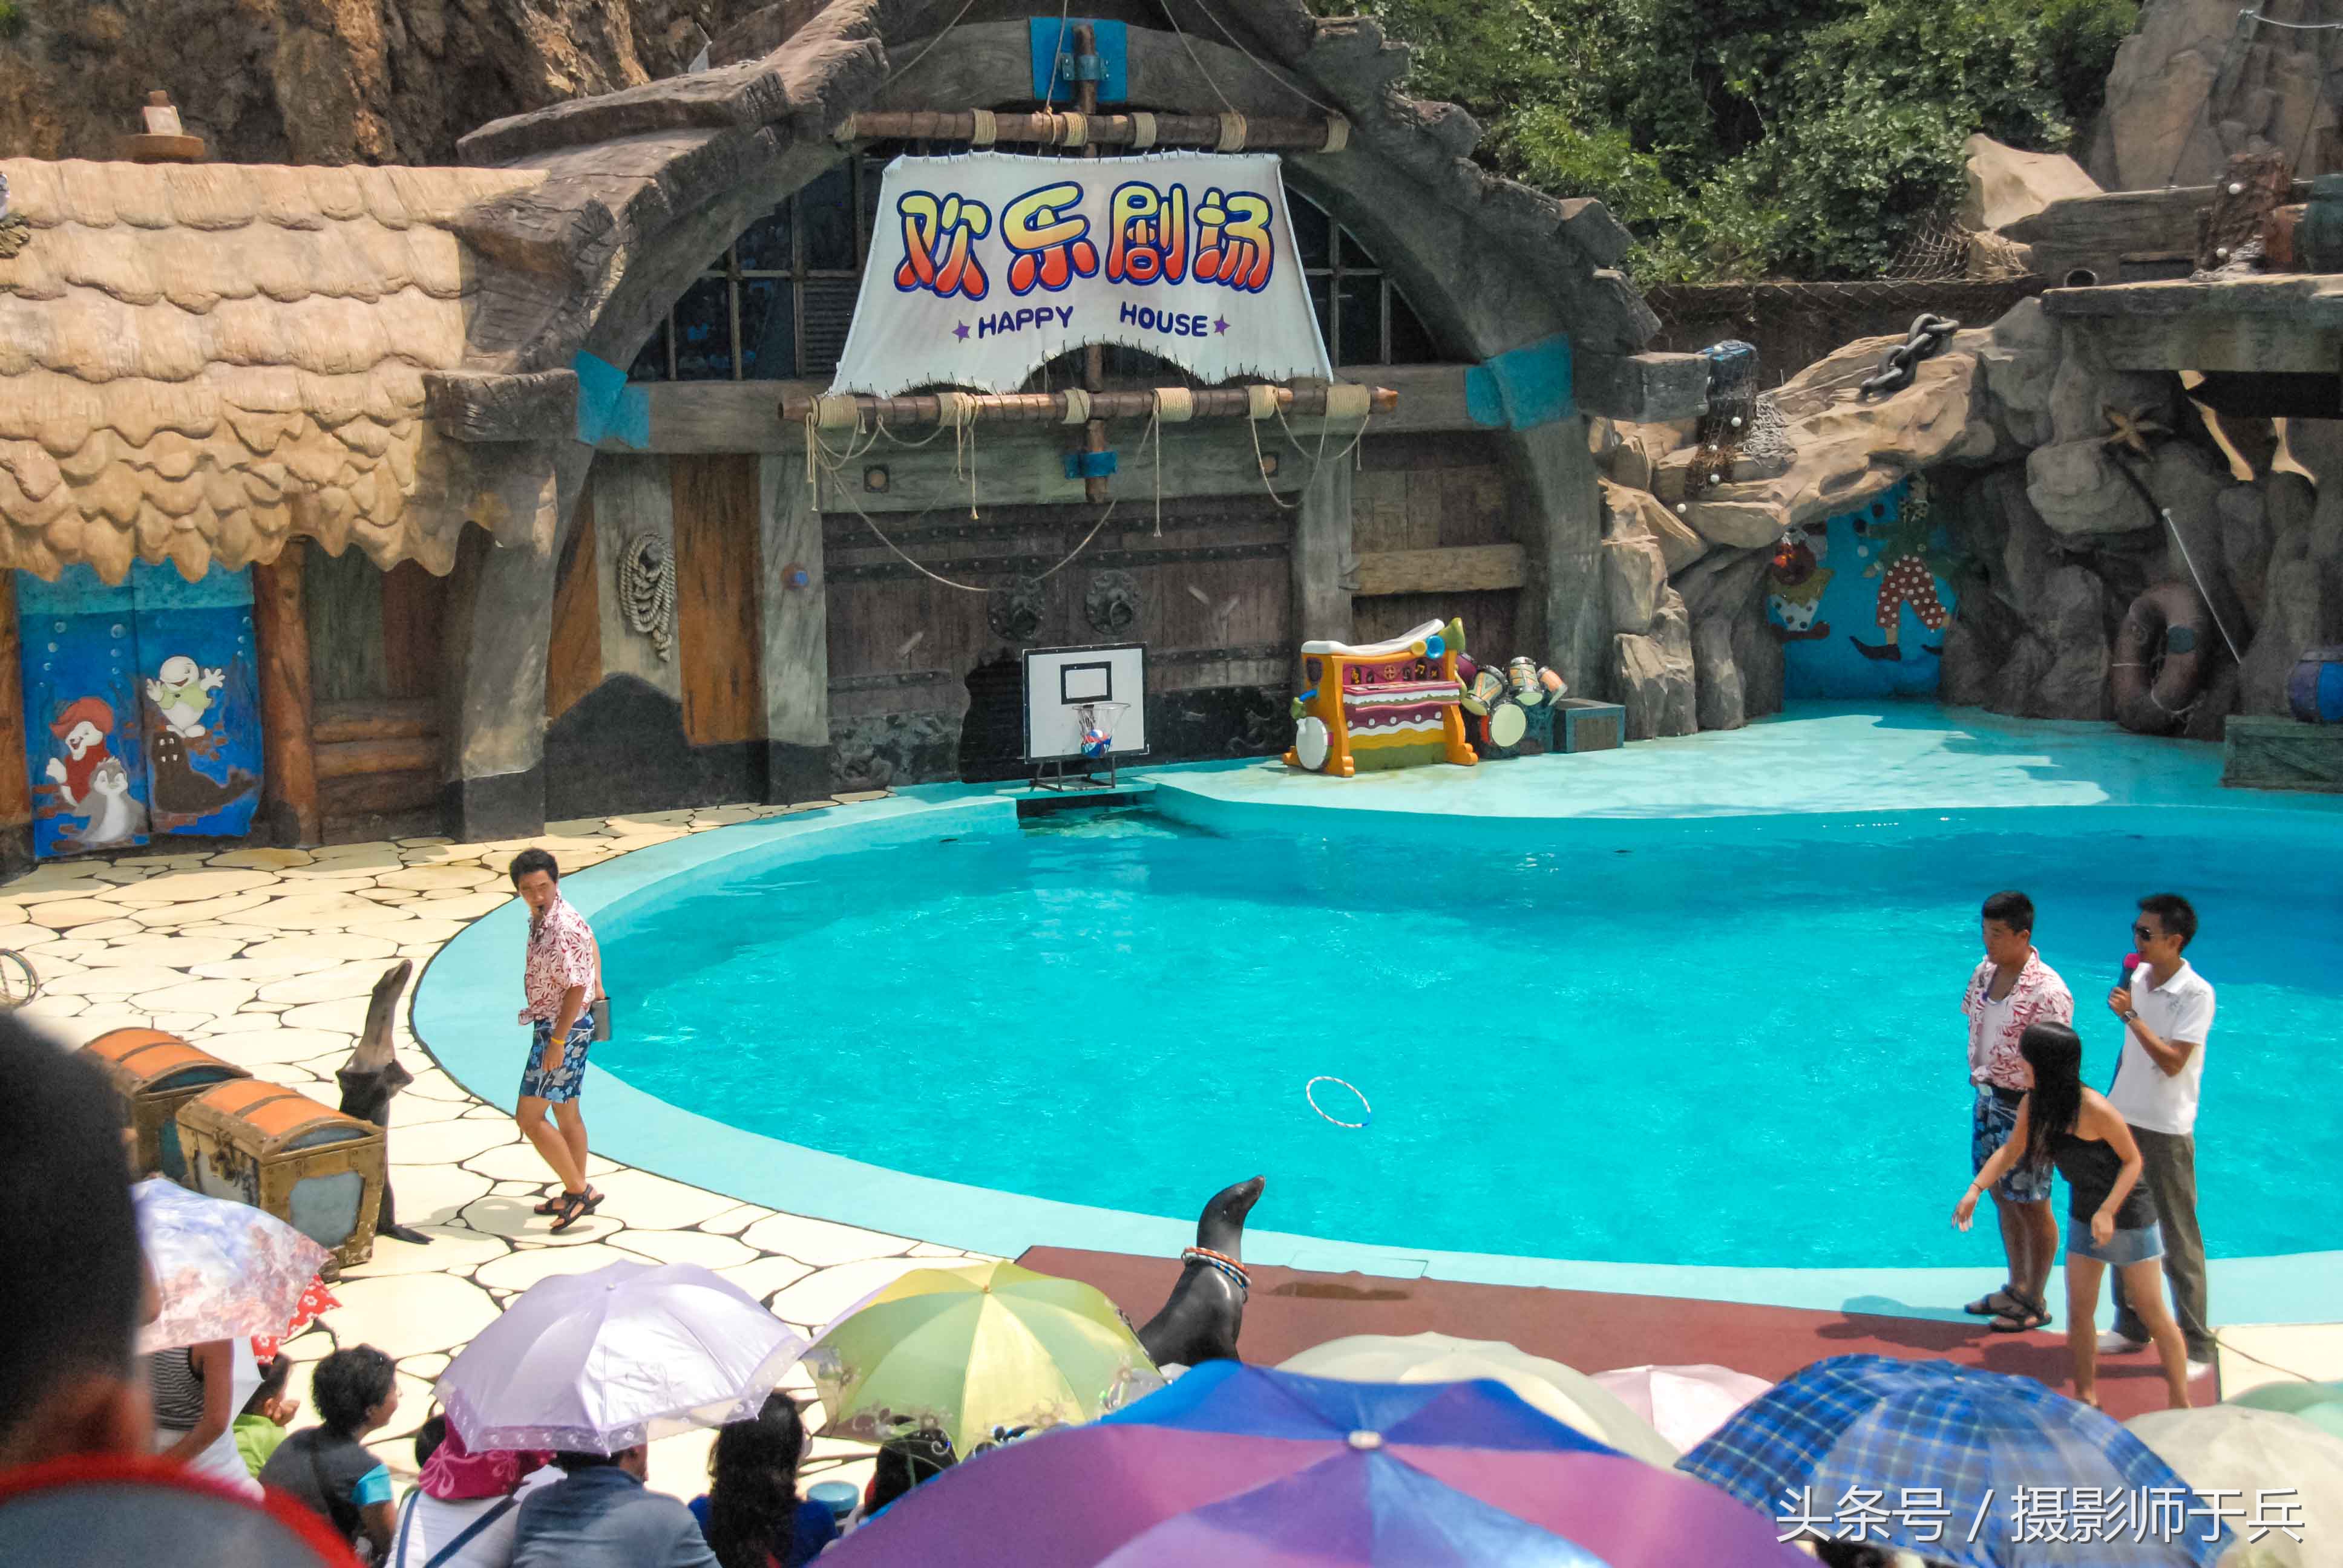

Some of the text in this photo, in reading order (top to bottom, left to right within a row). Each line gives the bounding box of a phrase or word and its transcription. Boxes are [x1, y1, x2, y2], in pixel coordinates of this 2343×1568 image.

[894, 180, 1275, 301] 欢乐剧场
[978, 301, 1208, 338] HAPPY HOUSE
